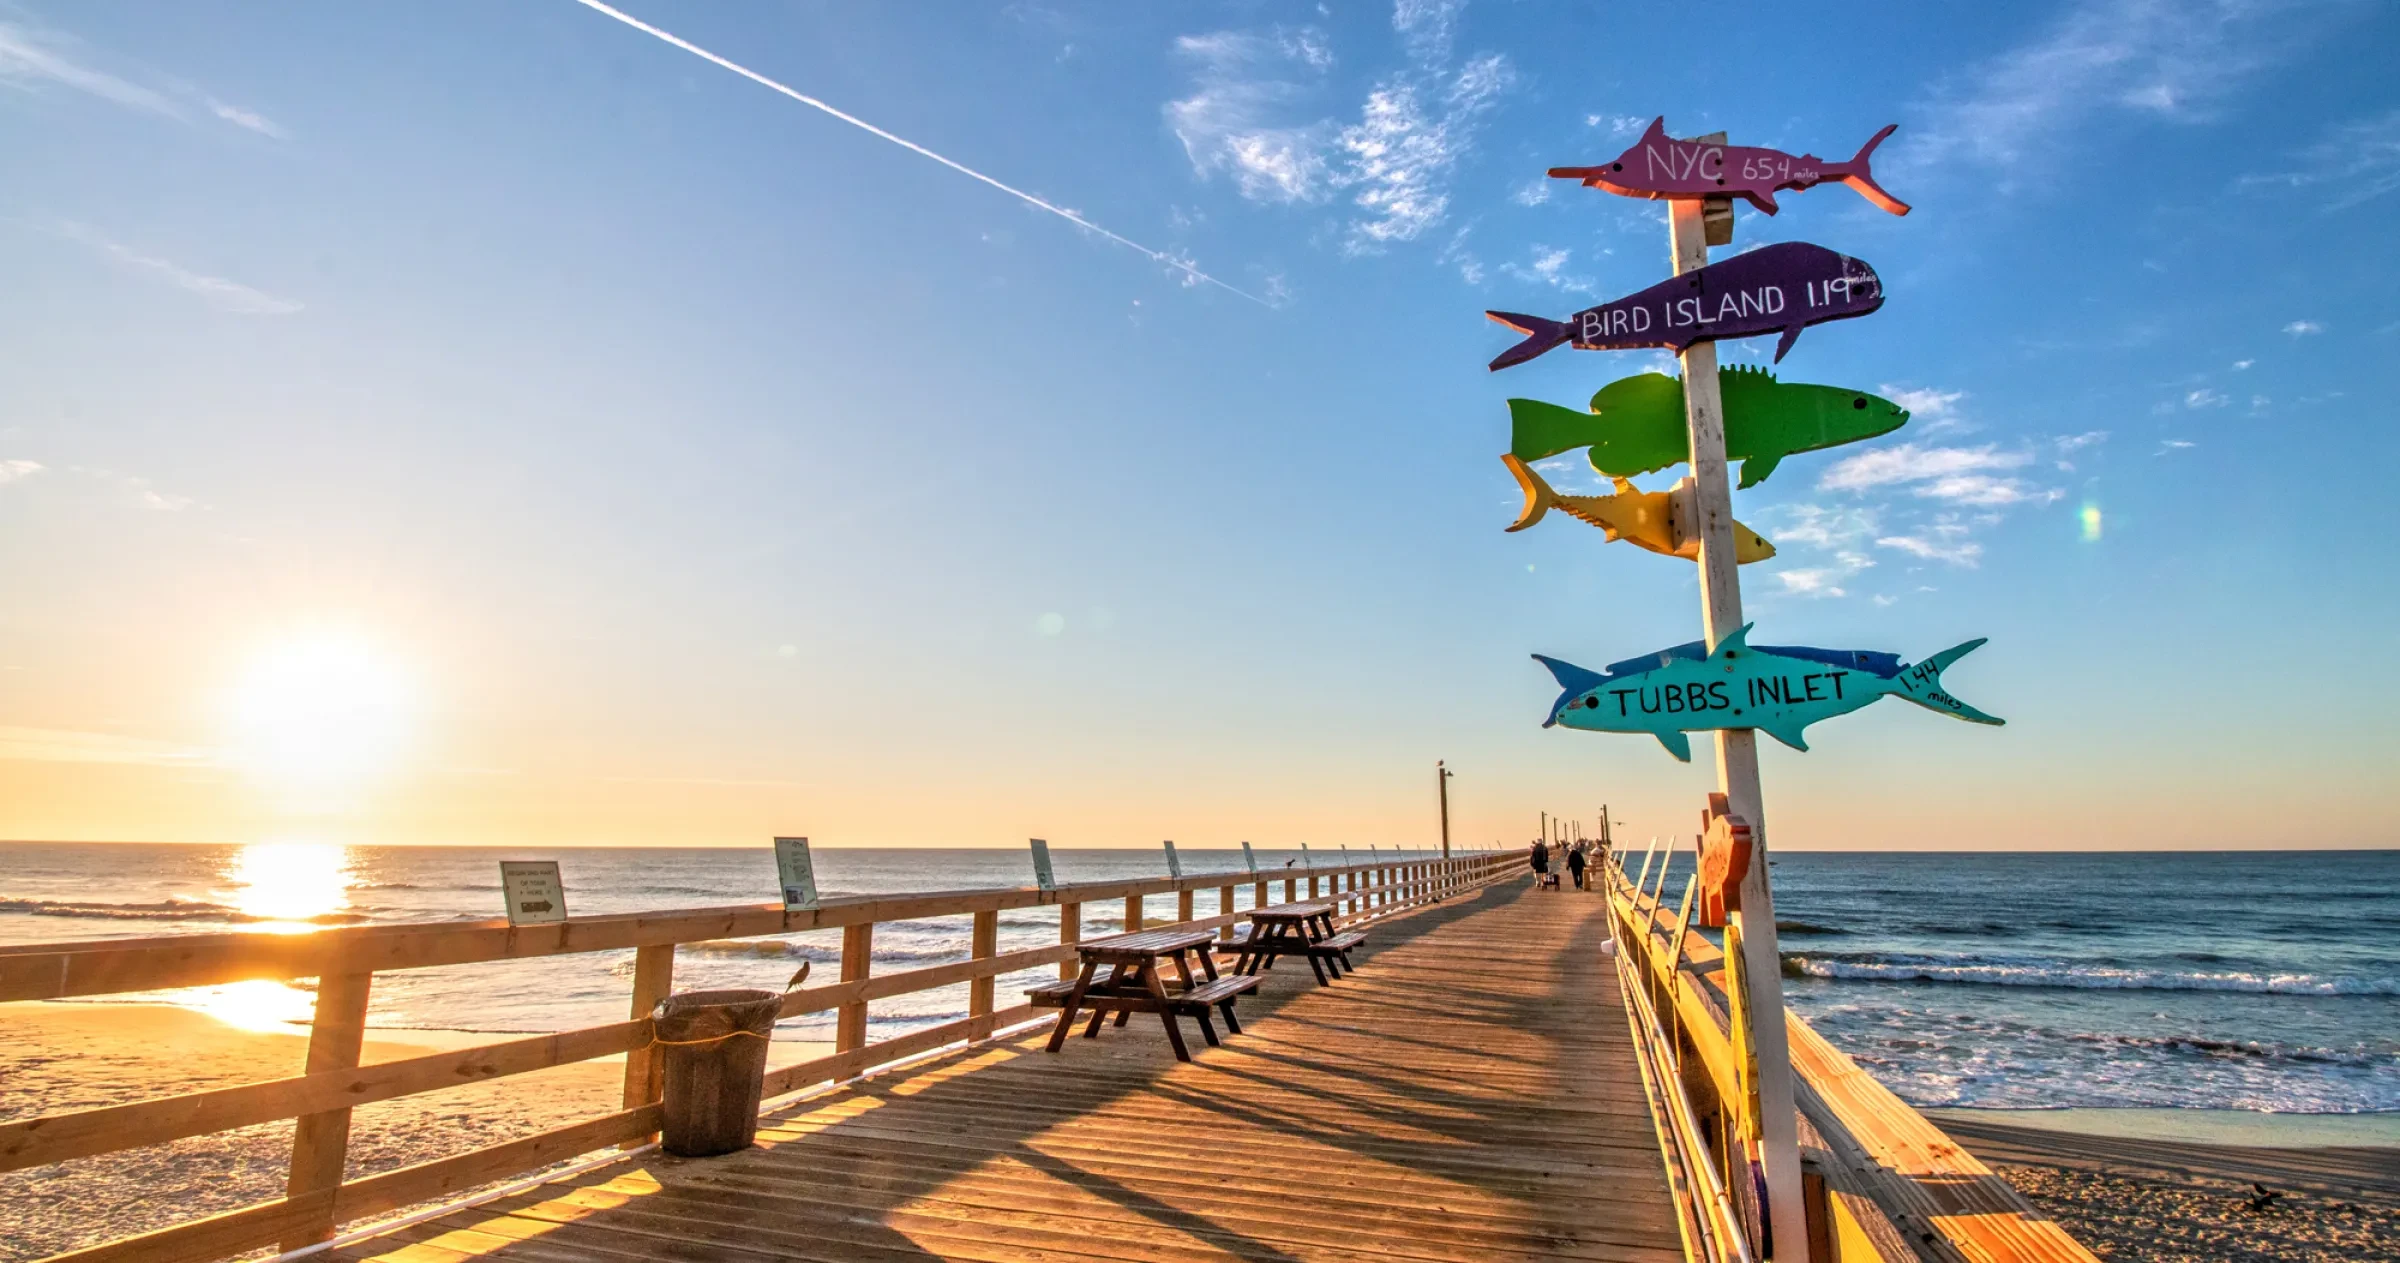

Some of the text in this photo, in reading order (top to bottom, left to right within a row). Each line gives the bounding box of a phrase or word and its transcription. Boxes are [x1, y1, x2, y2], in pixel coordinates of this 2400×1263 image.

[1645, 144, 1819, 181] NYC 654 miles
[1582, 271, 1877, 340] BIRD ISLAND 1.19 miles
[1609, 671, 1849, 717] TUBBS INLET
[1899, 658, 1940, 693] 1.44
[1928, 691, 1962, 709] miles
